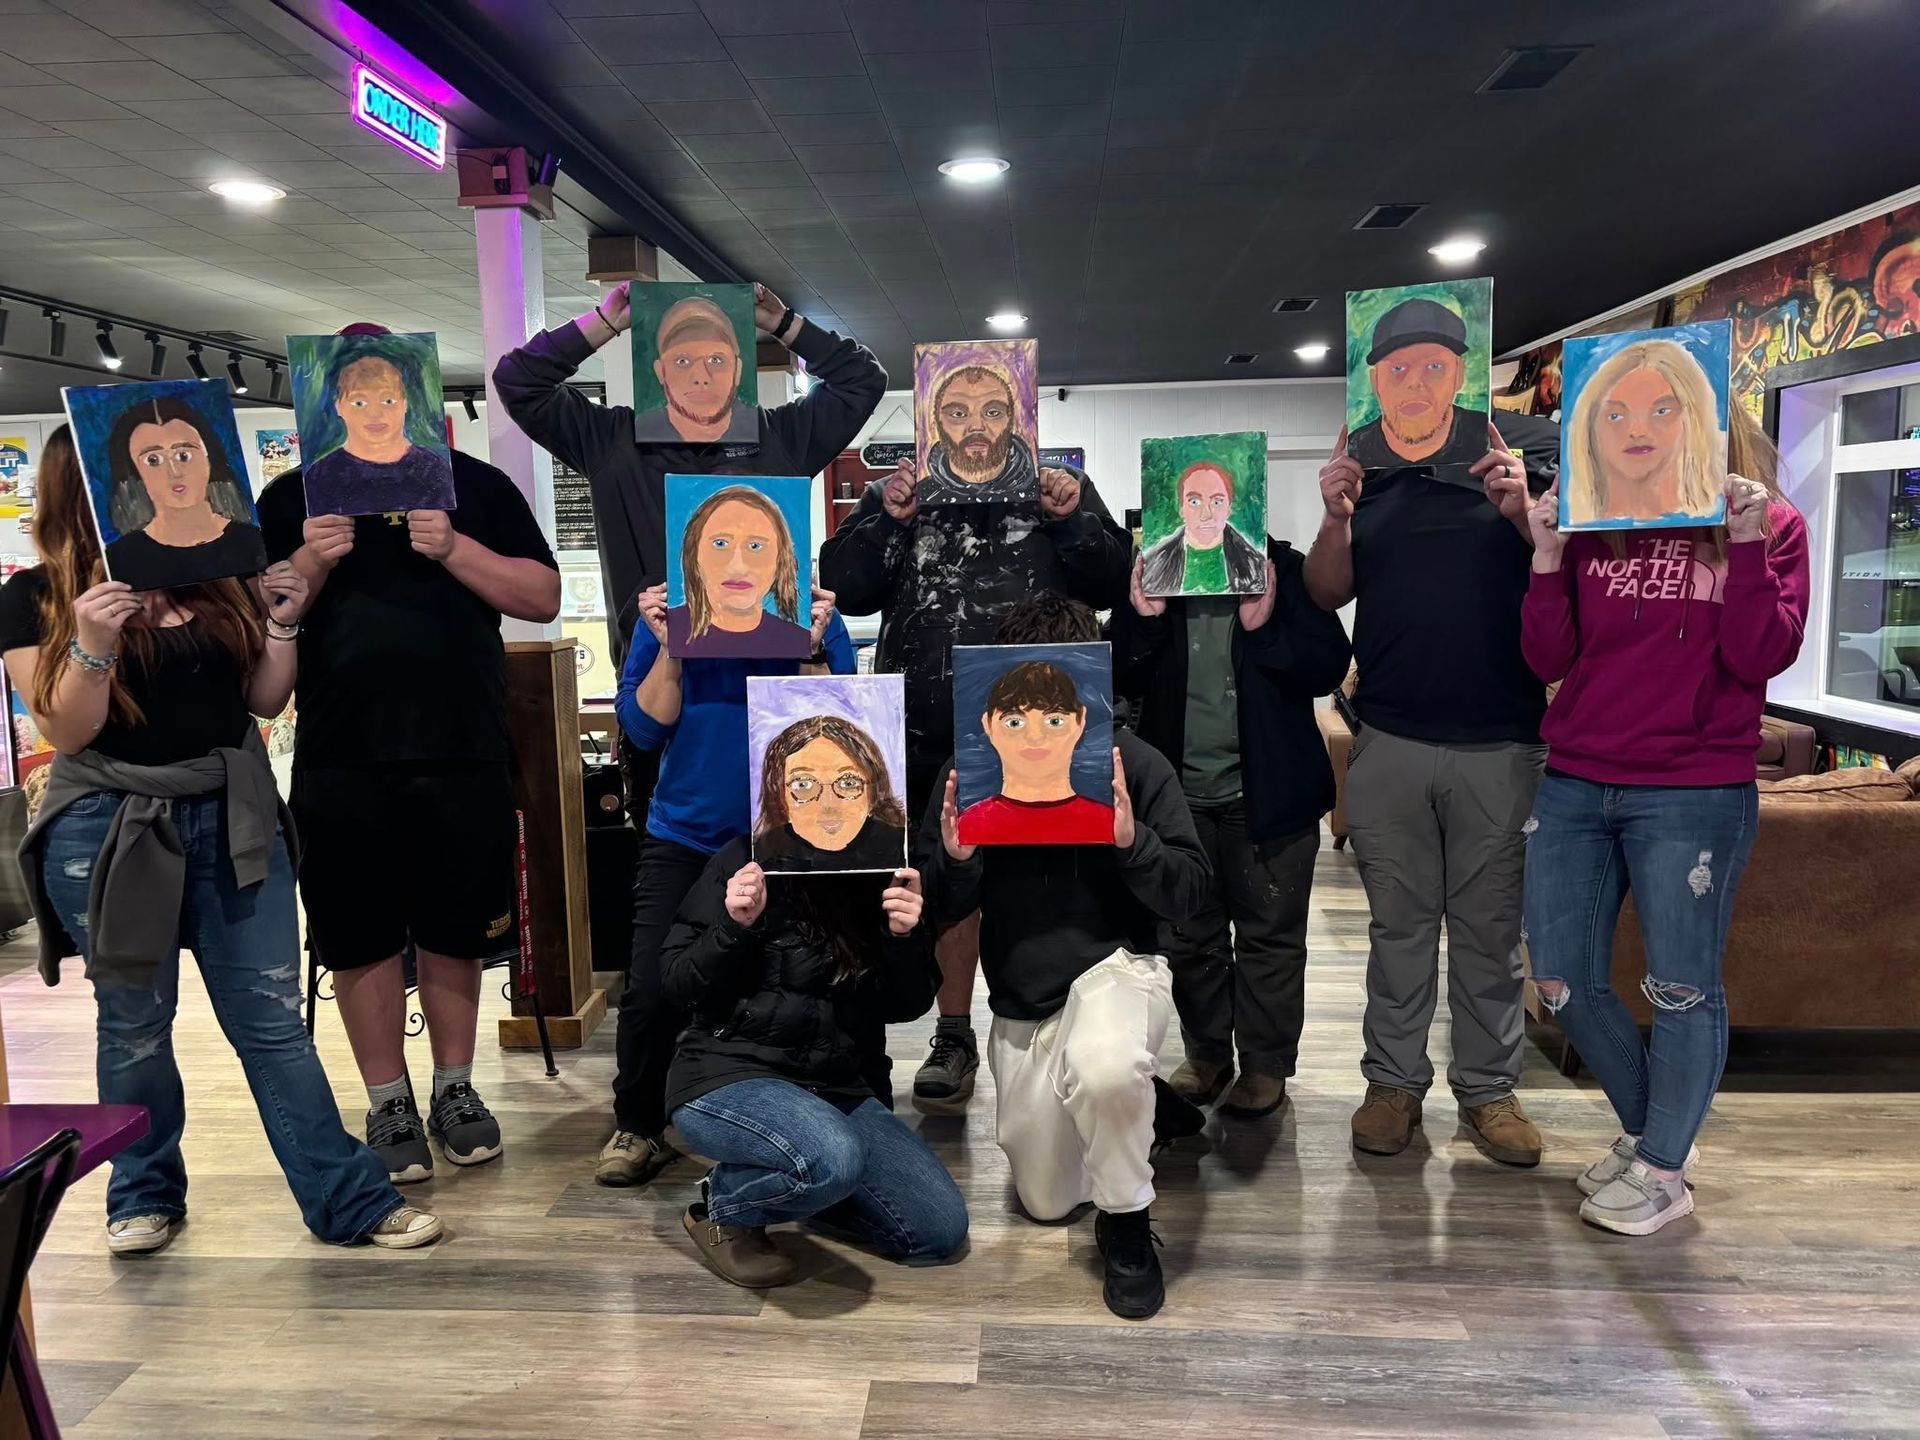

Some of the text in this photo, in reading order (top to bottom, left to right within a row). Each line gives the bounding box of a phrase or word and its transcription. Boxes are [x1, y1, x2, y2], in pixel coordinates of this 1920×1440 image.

[364, 83, 410, 135] ORDER
[1638, 539, 1692, 560] THE
[1586, 558, 1688, 579] NORTH
[1606, 578, 1681, 599] FACE
